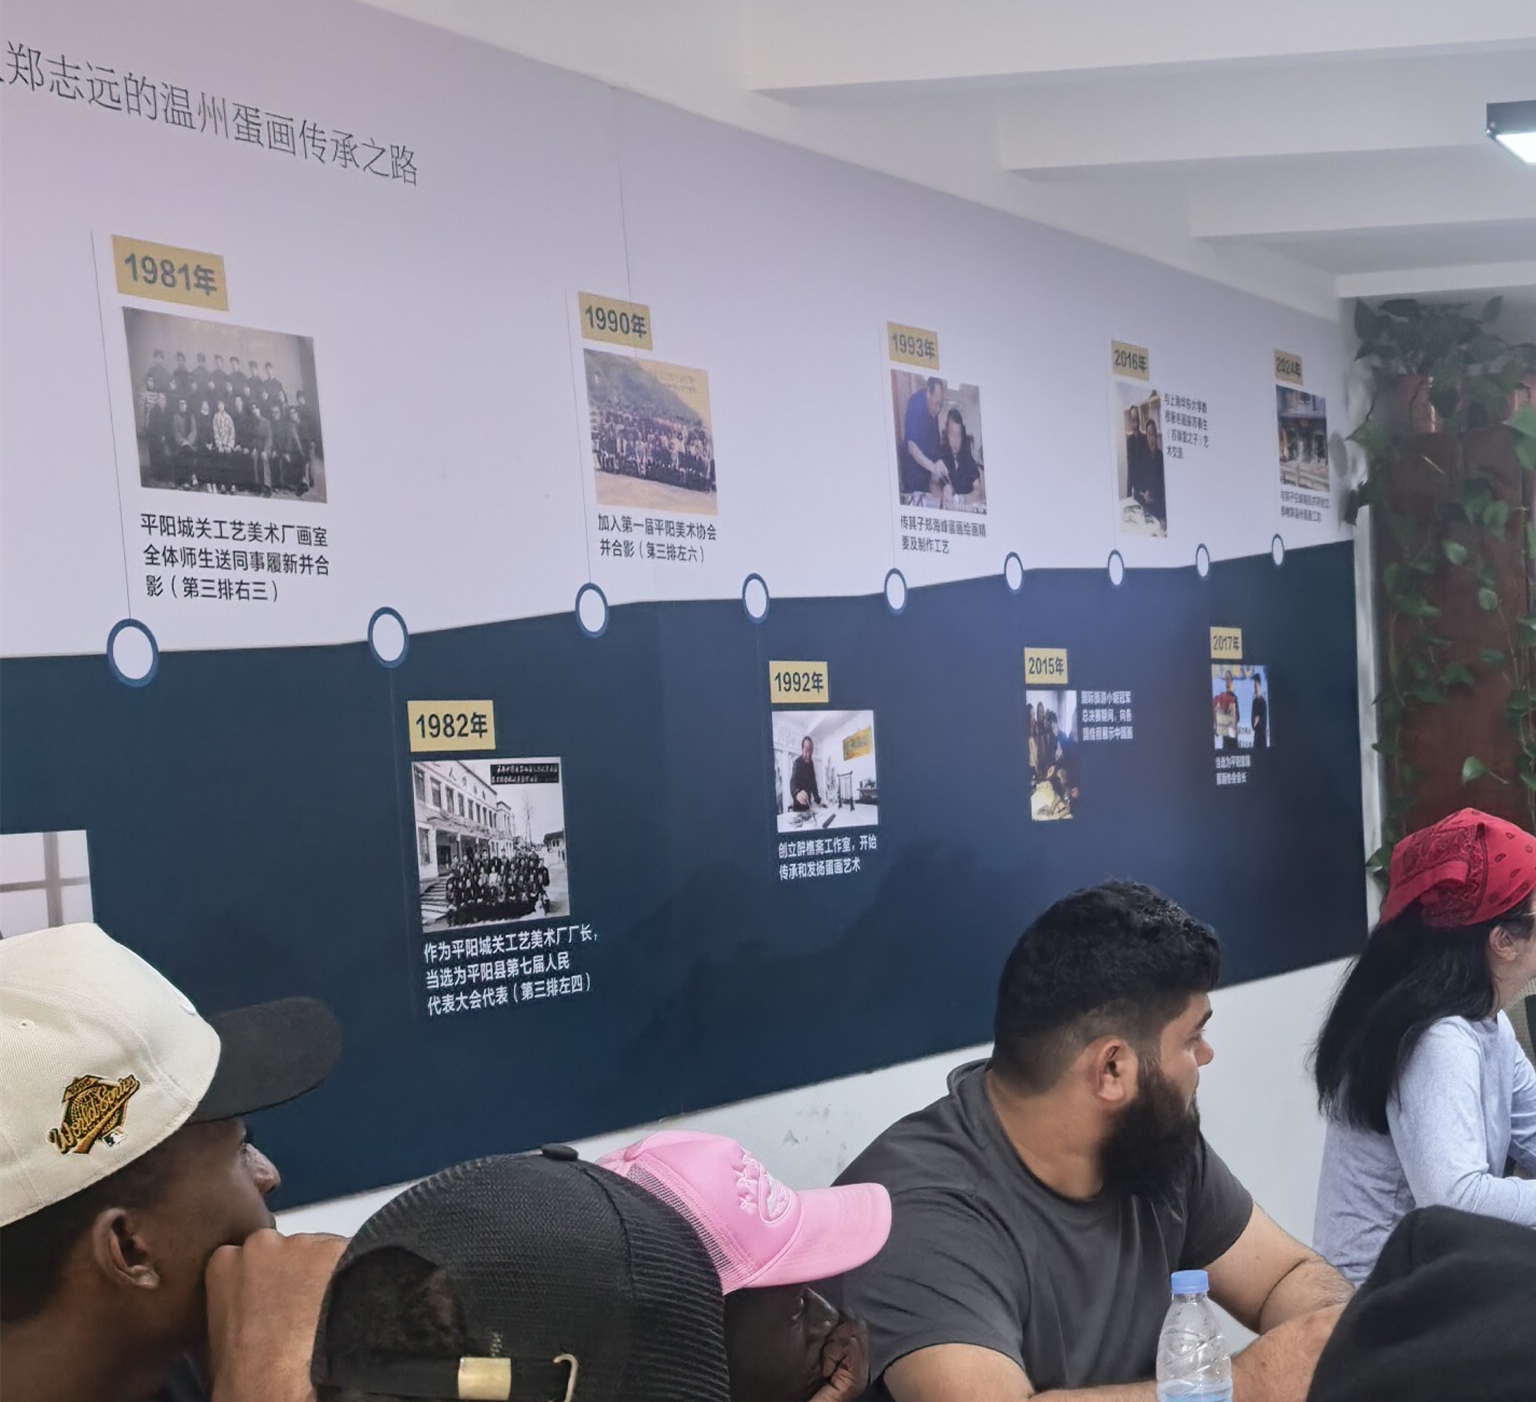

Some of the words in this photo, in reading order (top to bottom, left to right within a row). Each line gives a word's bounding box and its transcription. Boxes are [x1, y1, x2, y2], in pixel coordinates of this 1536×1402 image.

[0, 41, 418, 187] 郑志远的温州蛋画传承之路
[124, 252, 218, 297] 1981年
[585, 305, 647, 338] 1990年
[892, 333, 936, 360] 1993年
[1114, 349, 1148, 373] 2016年
[140, 513, 329, 547] 平阳城关工艺美术厂画室
[598, 512, 717, 541] 加入第一届平阳美术协会
[143, 544, 330, 577] 全体师生送同事履新并合
[1213, 636, 1240, 651] 2017年
[1028, 657, 1065, 676] 2015年
[774, 671, 824, 694] 1992年
[416, 712, 488, 739] 1982年
[779, 856, 861, 881] 传承和发扬蛋画艺术
[426, 951, 570, 990] 当选为平阳县第七届人民
